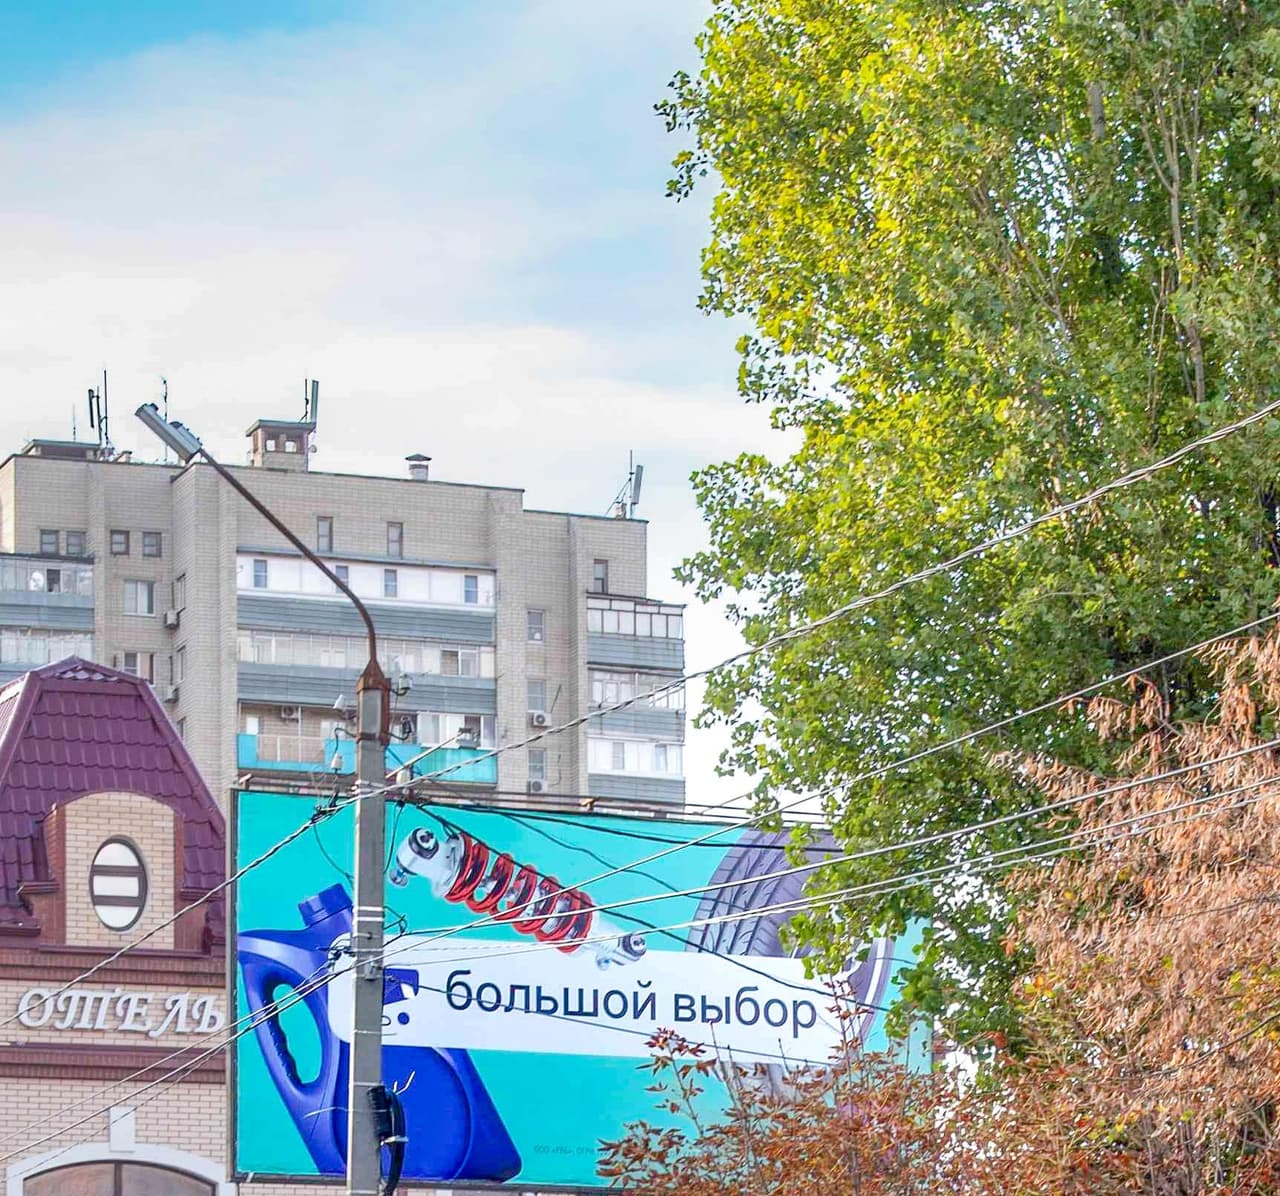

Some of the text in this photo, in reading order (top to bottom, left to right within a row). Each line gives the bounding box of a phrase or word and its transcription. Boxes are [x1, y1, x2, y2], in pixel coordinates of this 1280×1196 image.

[17, 986, 226, 1038] ОТЕЛЬ
[446, 969, 817, 1039] большой выбор
